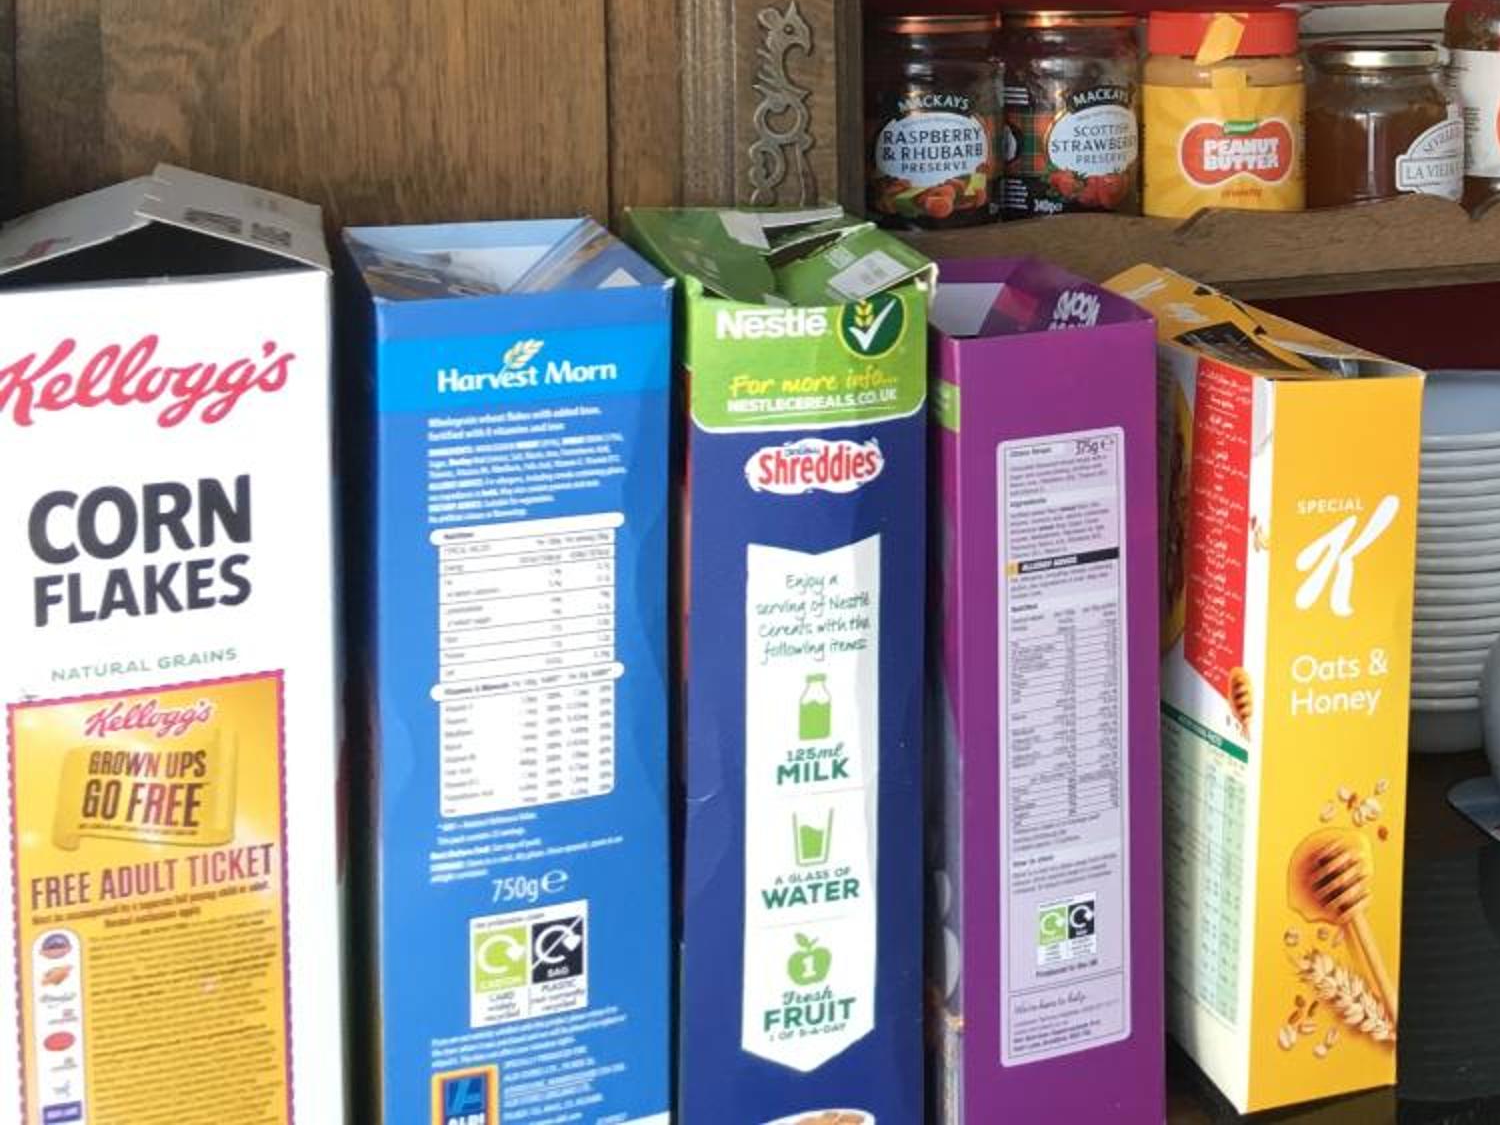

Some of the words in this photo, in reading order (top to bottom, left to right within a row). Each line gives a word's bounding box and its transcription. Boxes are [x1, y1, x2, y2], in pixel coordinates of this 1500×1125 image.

[897, 93, 970, 112] MACKAYS
[883, 127, 982, 146] RASPBERRY
[1203, 138, 1280, 156] PEANUT
[882, 146, 896, 160] &
[901, 143, 983, 161] RHUBARB
[1203, 155, 1279, 171] BUTTER
[901, 160, 968, 173] PRESERVE
[0, 334, 296, 429] Kellogg's
[437, 367, 538, 393] Harvest
[544, 360, 617, 385] Morn
[729, 375, 775, 399] For
[782, 373, 835, 393] more
[757, 443, 878, 486] Shreddies
[28, 473, 252, 565] CORN
[1296, 497, 1364, 514] SPECIAL
[1295, 494, 1400, 618] K
[34, 553, 252, 628] FLAKES
[786, 574, 824, 596] Enjoy
[829, 575, 838, 586] a
[755, 601, 806, 621] serving
[811, 599, 824, 618] of
[817, 618, 848, 635] with
[849, 615, 870, 631] the
[51, 658, 152, 682] NATURAL
[156, 647, 238, 674] GRAINS
[761, 640, 825, 666] following
[1291, 654, 1361, 683] Oats
[1369, 647, 1388, 676] &
[1291, 689, 1382, 716] Honey
[84, 699, 213, 737] Kellogg's
[88, 750, 161, 777] GROWN
[165, 749, 207, 778] UPS
[786, 742, 844, 763] 125ml
[776, 757, 850, 786] MILK
[82, 779, 122, 820] GO
[127, 781, 203, 828] FREE
[31, 872, 91, 910] FREE
[99, 858, 178, 901] ADULT
[188, 842, 276, 883] TICKET
[491, 875, 539, 904] 750g
[774, 875, 784, 886] A
[788, 869, 830, 885] GLASS
[834, 866, 851, 879] OF
[761, 878, 861, 910] WATER
[782, 985, 833, 1007] Fresh
[763, 996, 857, 1033] FRUIT
